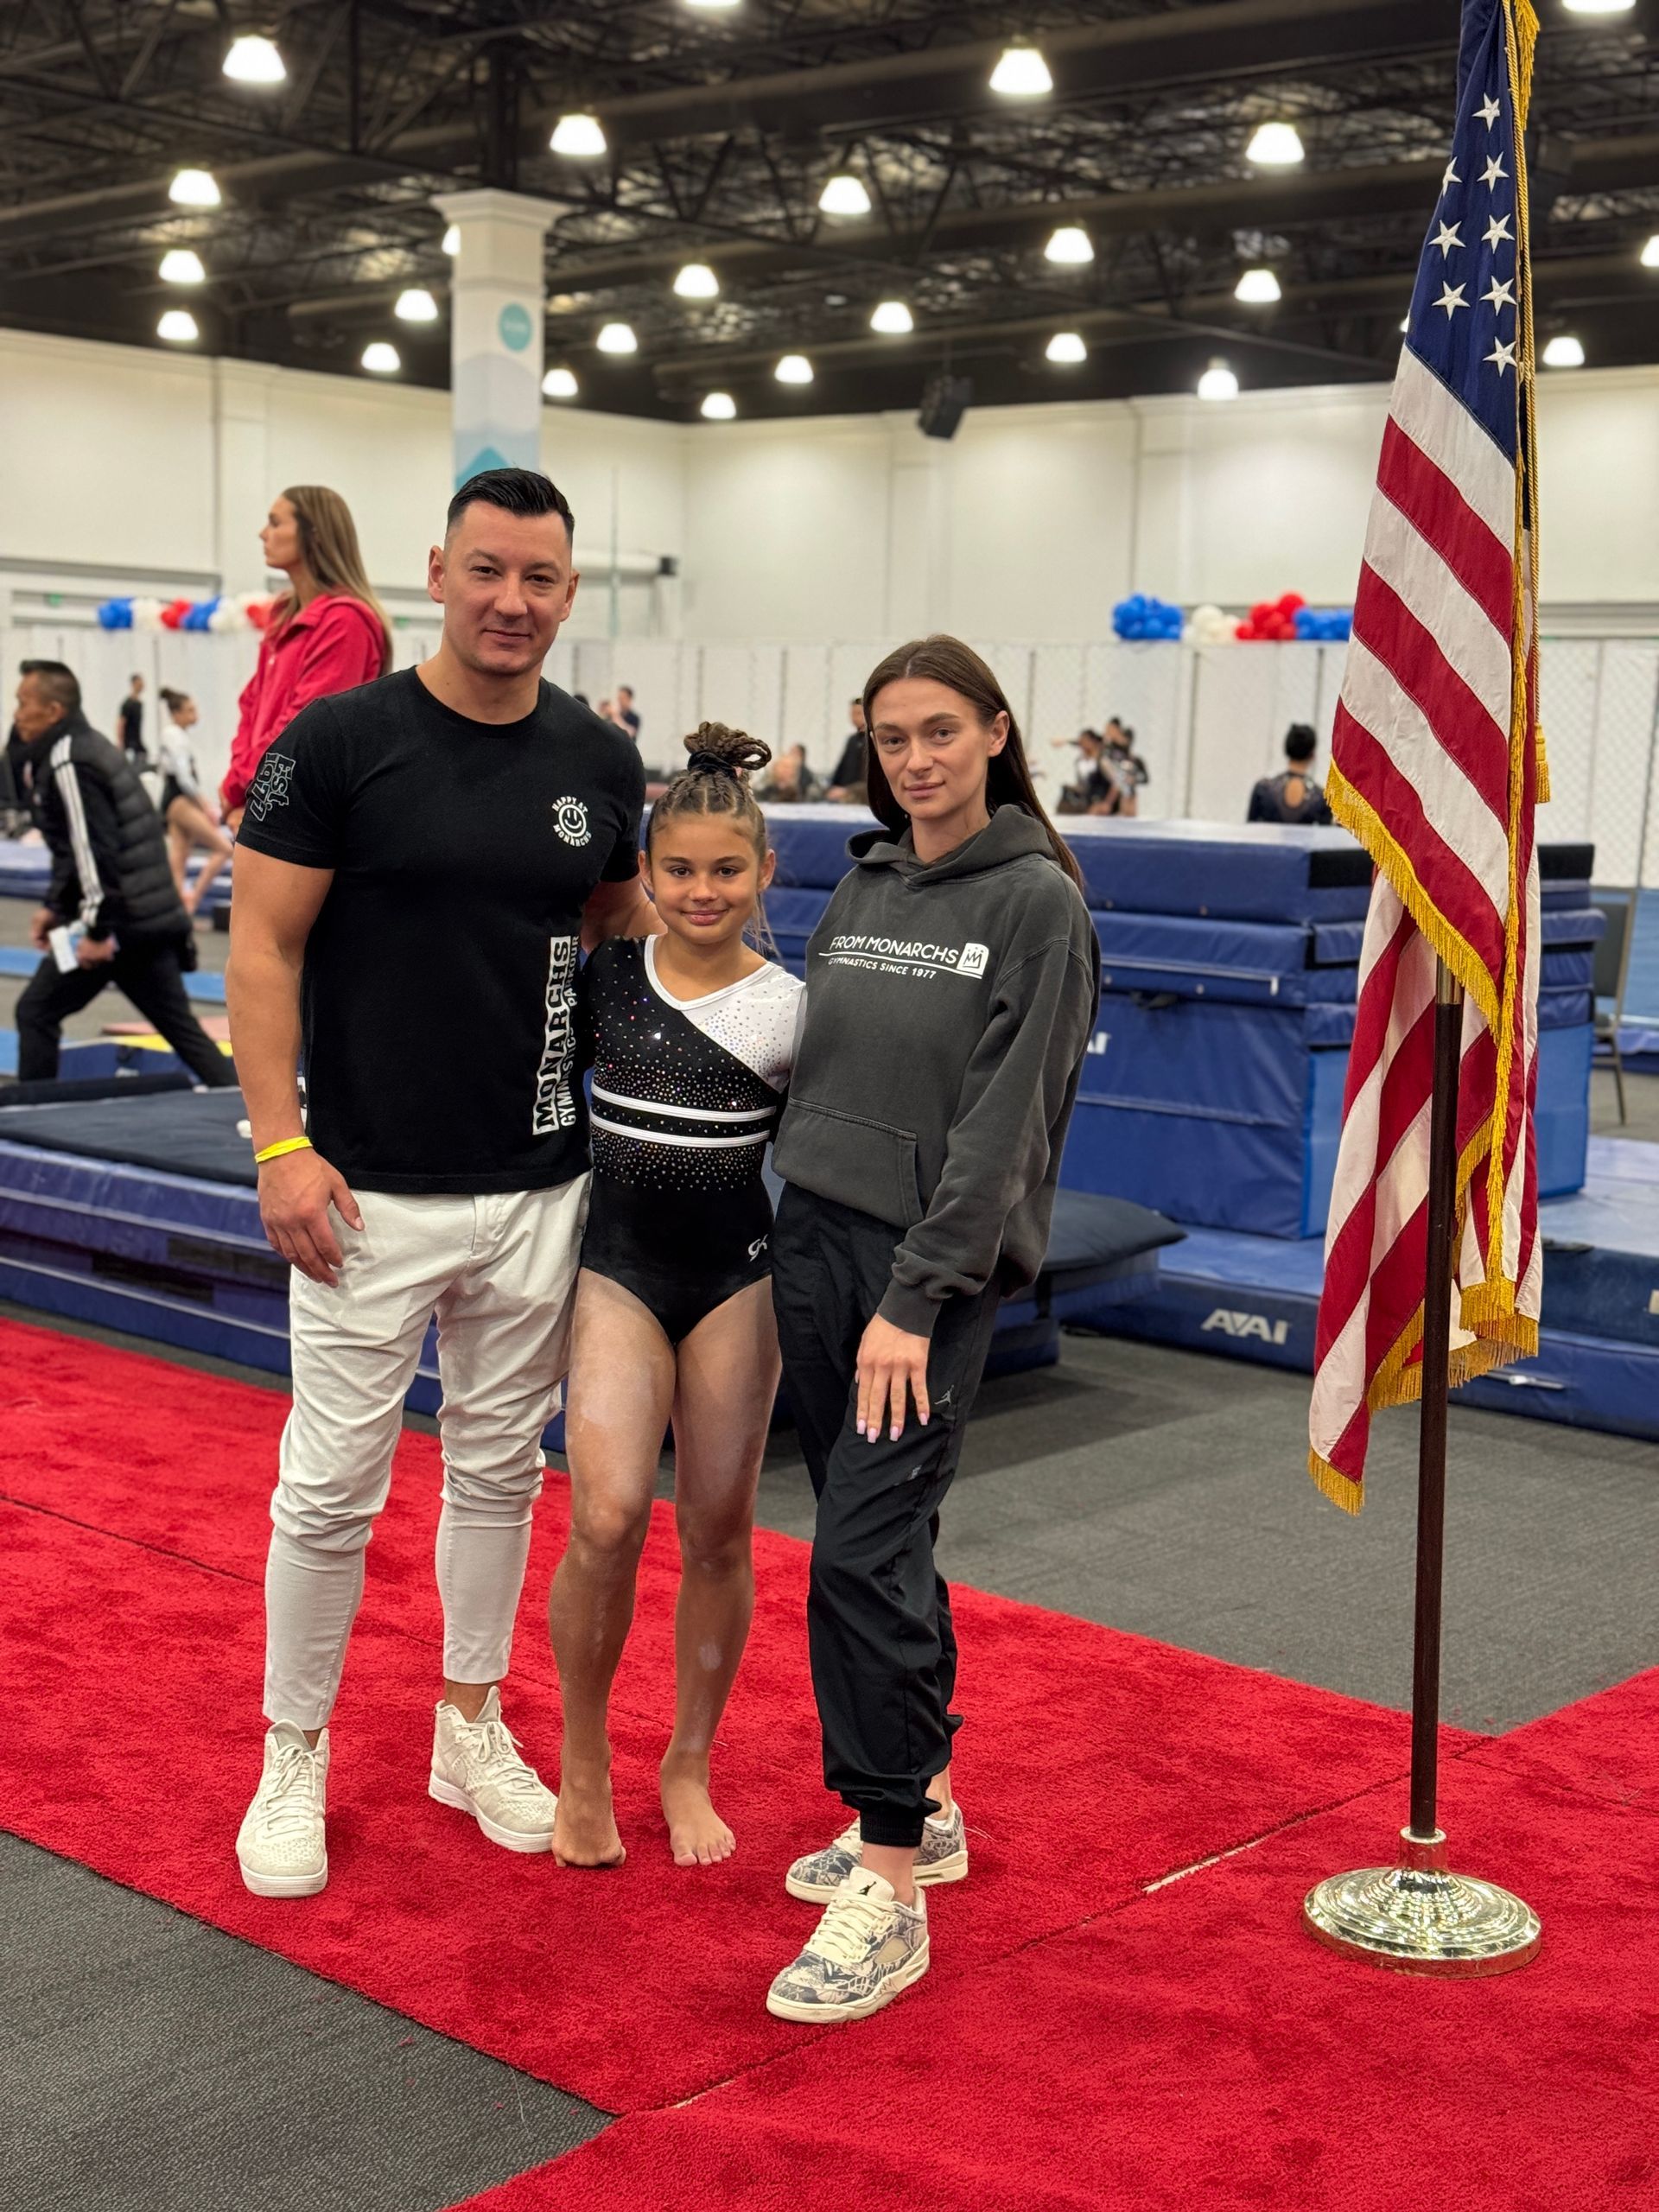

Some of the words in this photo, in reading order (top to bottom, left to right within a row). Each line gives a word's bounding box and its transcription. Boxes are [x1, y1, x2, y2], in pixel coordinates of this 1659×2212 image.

[552, 796, 577, 811] HAPPY
[578, 802, 588, 812] AT
[553, 823, 592, 847] MONARCHS
[829, 936, 867, 950] FROM
[866, 937, 959, 964] MONARCHS
[828, 957, 878, 970] GYMNASTICS
[880, 962, 909, 976] SINCE
[912, 968, 937, 980] 1977
[535, 939, 569, 1131] MONARCHS
